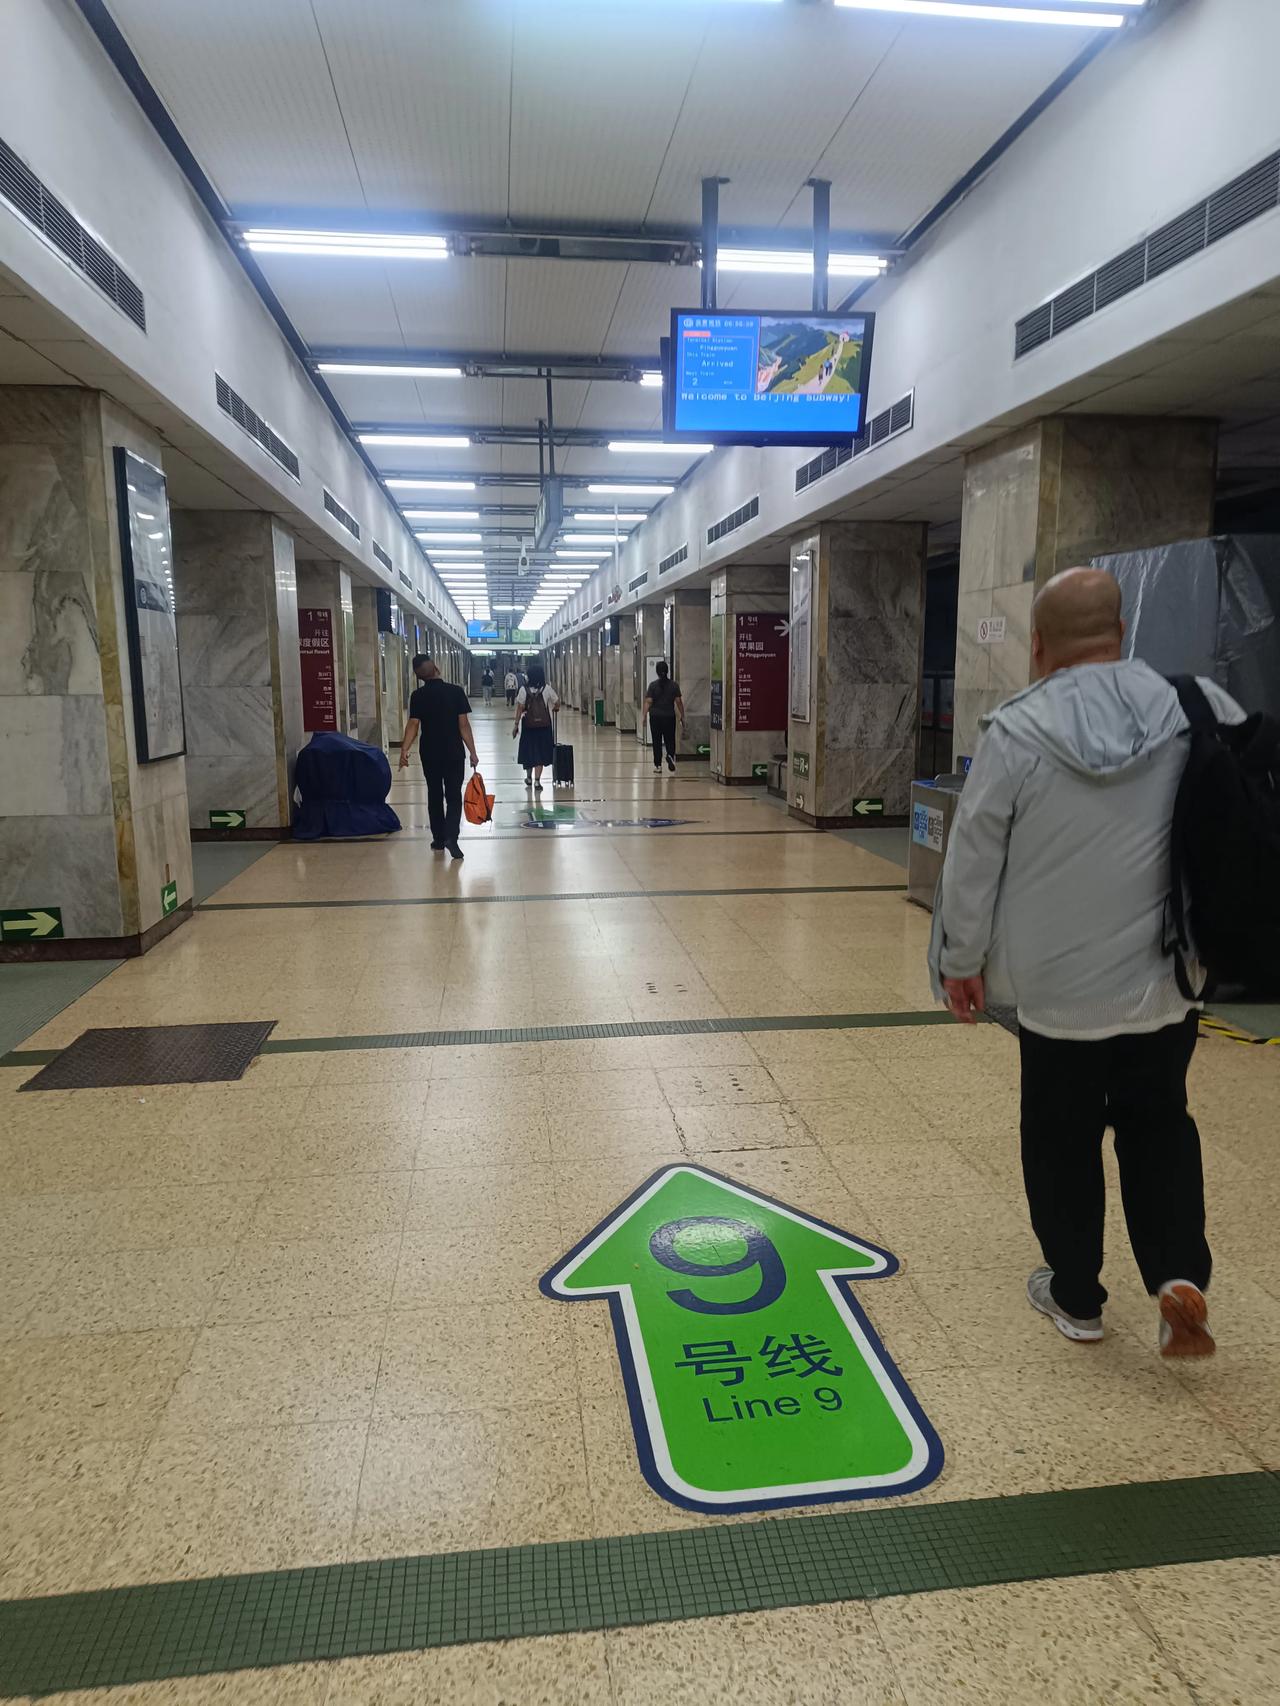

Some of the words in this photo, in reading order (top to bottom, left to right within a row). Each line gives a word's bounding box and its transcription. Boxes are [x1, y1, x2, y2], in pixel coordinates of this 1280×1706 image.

[702, 360, 734, 368] Arrived
[692, 378, 699, 387] 2
[681, 393, 727, 401] Welcome
[735, 393, 747, 401] to
[307, 611, 313, 622] 1
[739, 616, 744, 626] 1
[739, 641, 764, 651] 苹果园
[649, 1216, 786, 1315] 9
[674, 1332, 844, 1387] 号线
[703, 1394, 802, 1423] Line
[813, 1387, 843, 1411] 9
